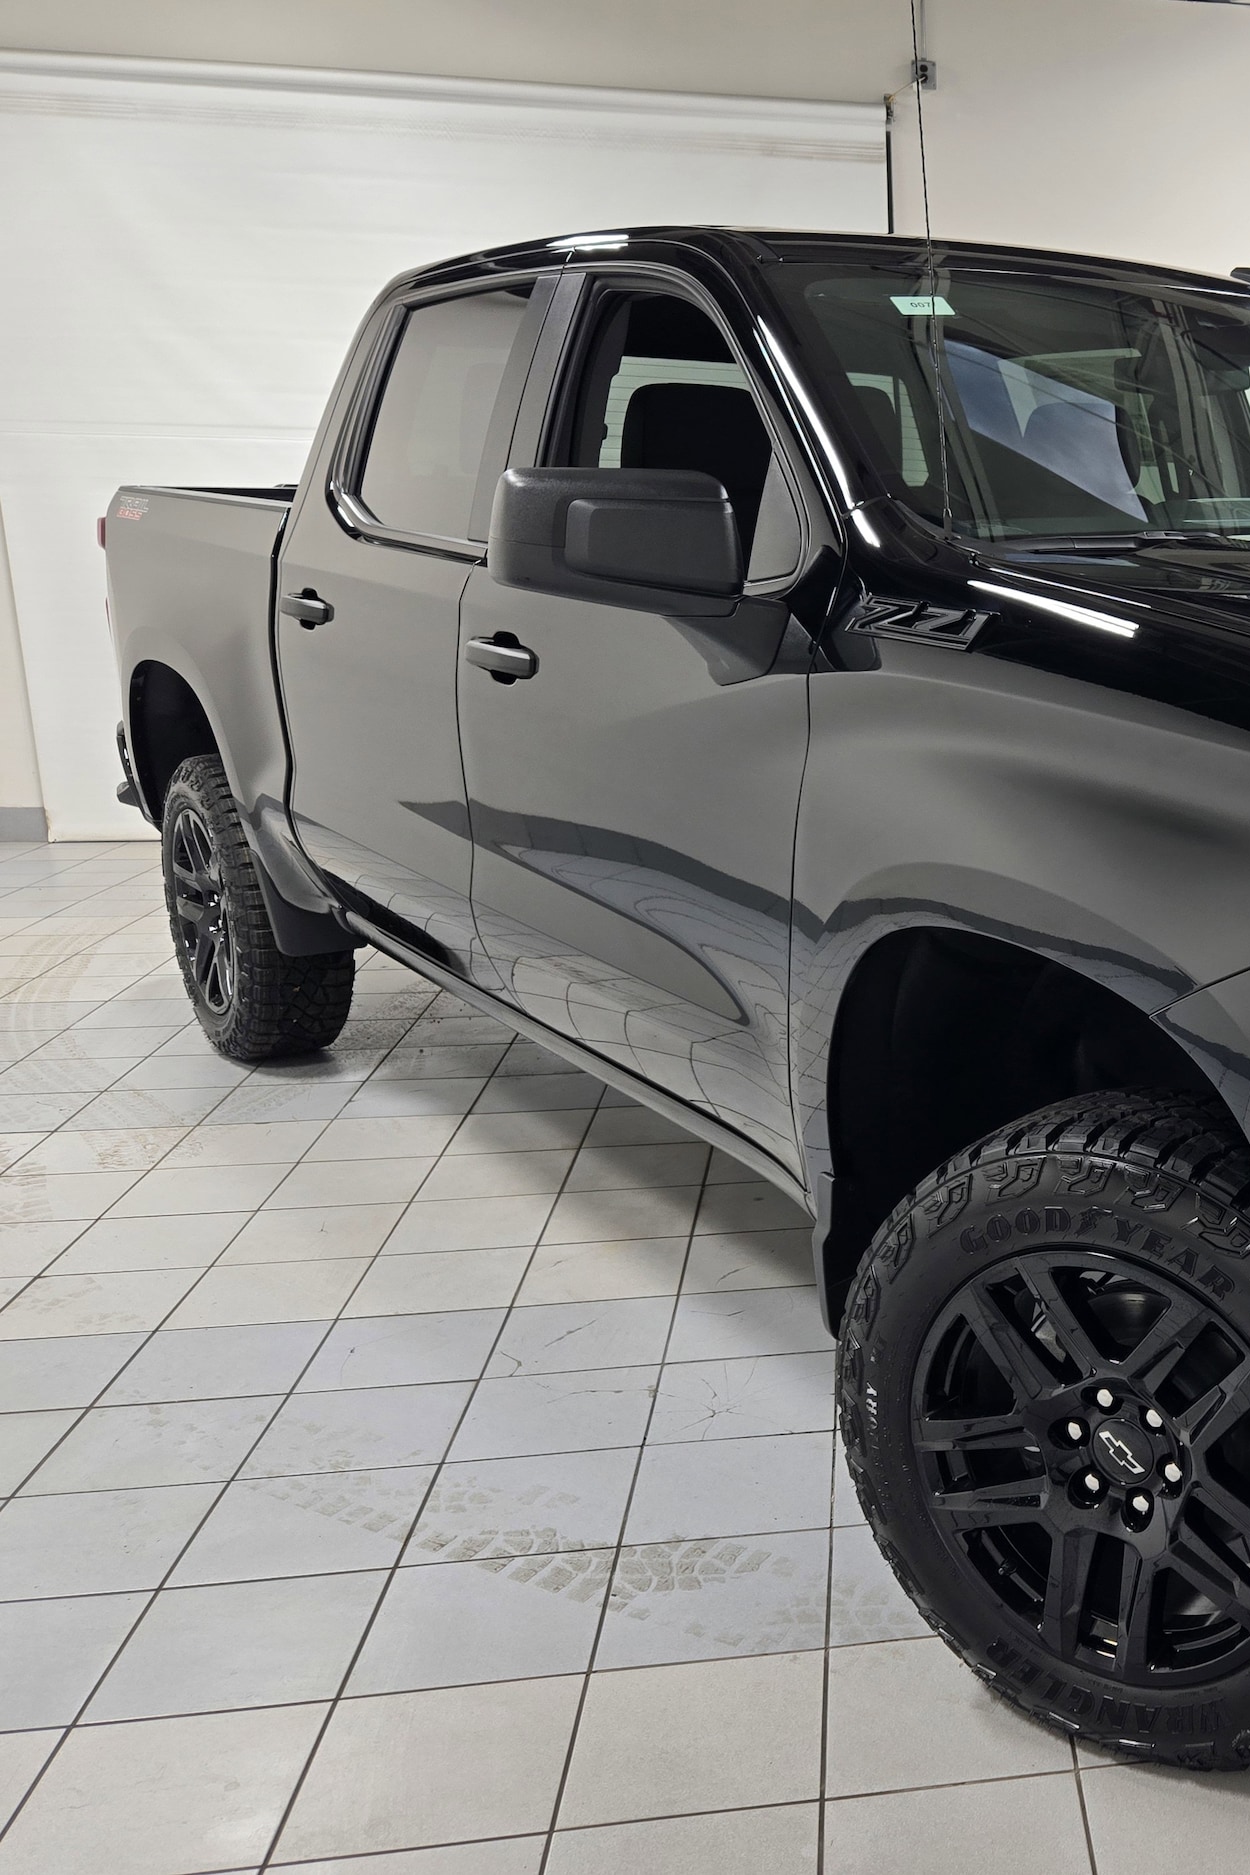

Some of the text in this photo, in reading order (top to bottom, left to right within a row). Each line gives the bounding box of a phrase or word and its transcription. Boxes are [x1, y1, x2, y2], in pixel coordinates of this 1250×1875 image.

[846, 593, 1001, 651] Z71
[958, 1206, 1236, 1302] GOODYEAR
[986, 1635, 1232, 1735] WRANGLER
